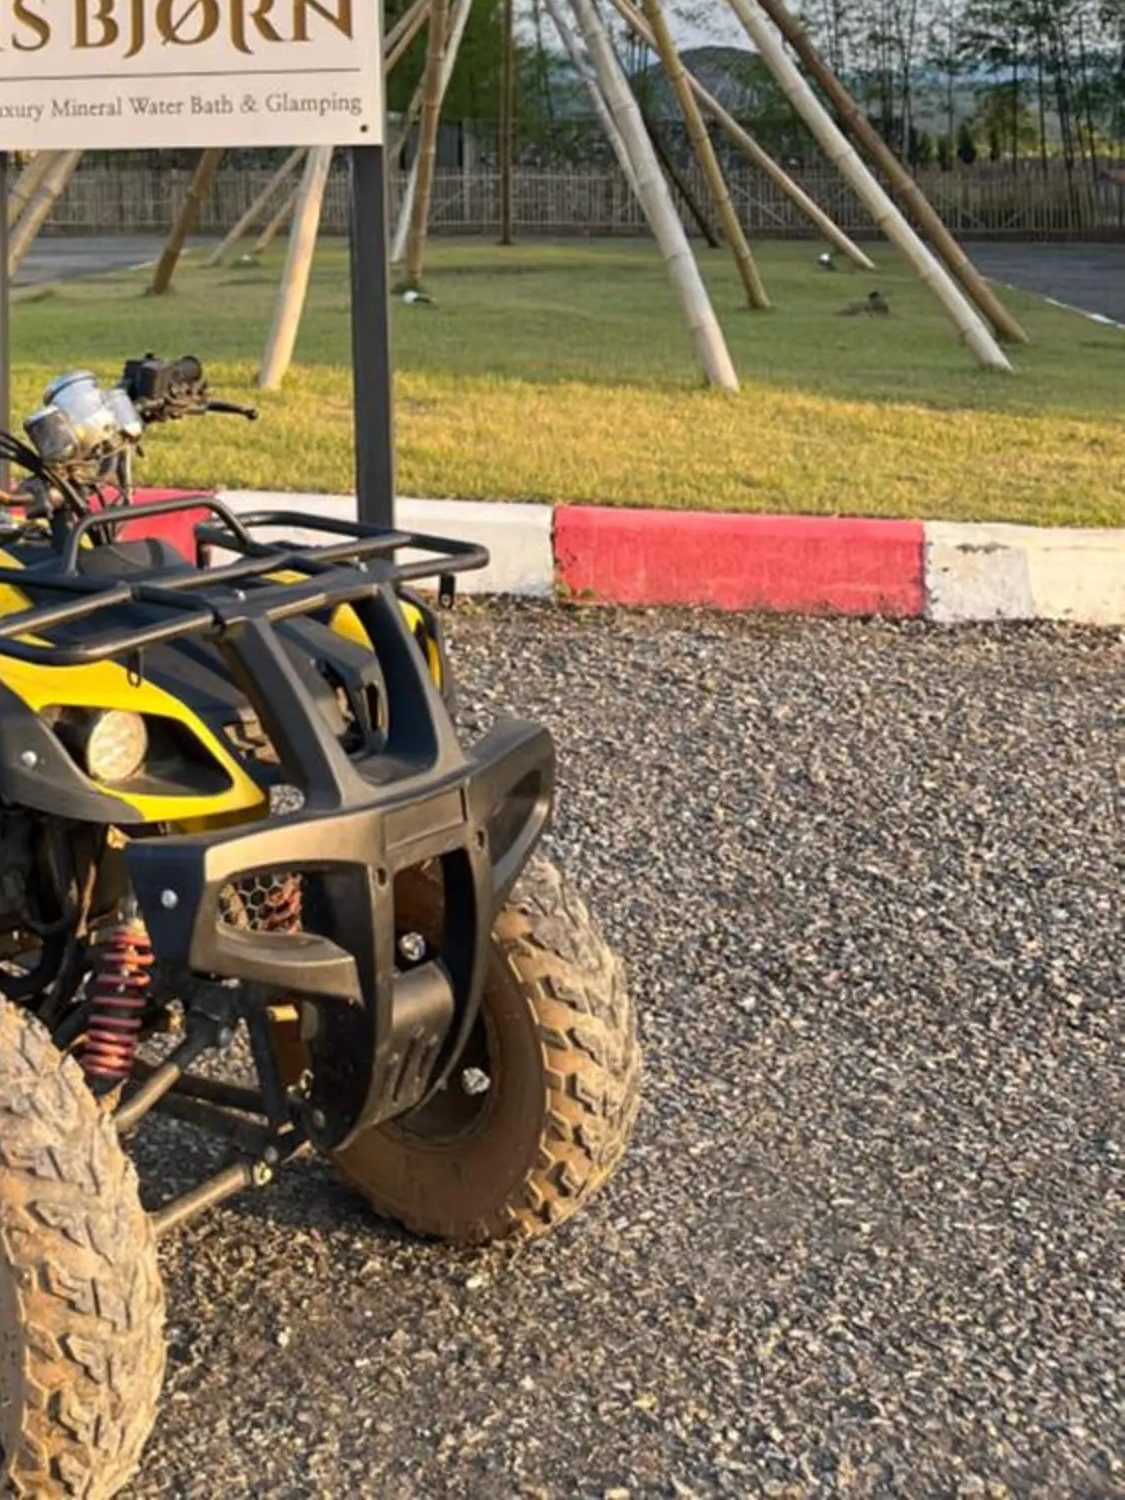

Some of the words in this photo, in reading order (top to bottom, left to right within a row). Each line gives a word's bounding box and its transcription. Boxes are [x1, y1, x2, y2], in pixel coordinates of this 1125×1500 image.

[50, 97, 122, 118] Mineral
[128, 96, 184, 116] Water
[190, 94, 234, 115] Bath
[240, 93, 260, 114] &
[265, 92, 363, 116] Glamping
